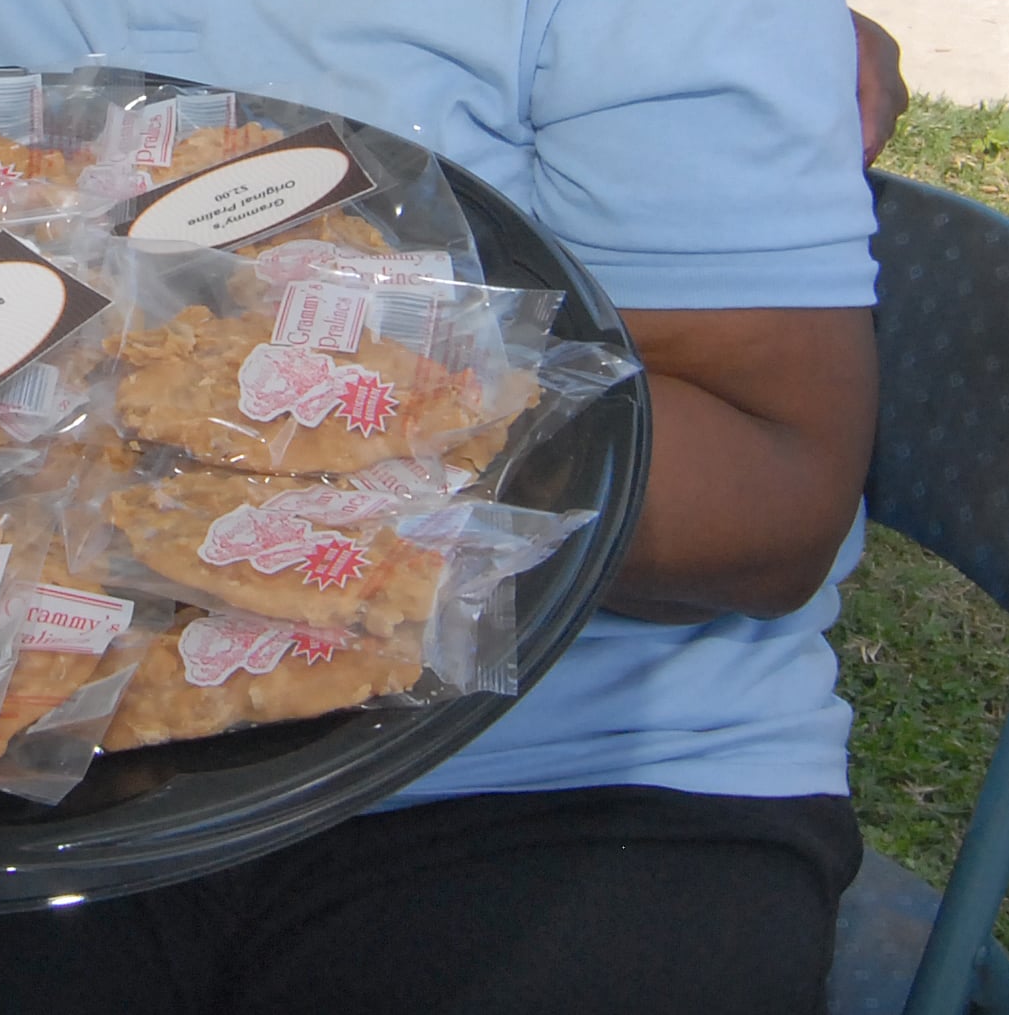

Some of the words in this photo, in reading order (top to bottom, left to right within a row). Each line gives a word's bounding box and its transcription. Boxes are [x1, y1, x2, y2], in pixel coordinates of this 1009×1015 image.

[241, 180, 296, 207] Original
[187, 201, 237, 226] Praline
[212, 198, 285, 231] Grammy's
[287, 284, 327, 345] Grammy's
[318, 295, 353, 349] Pralines
